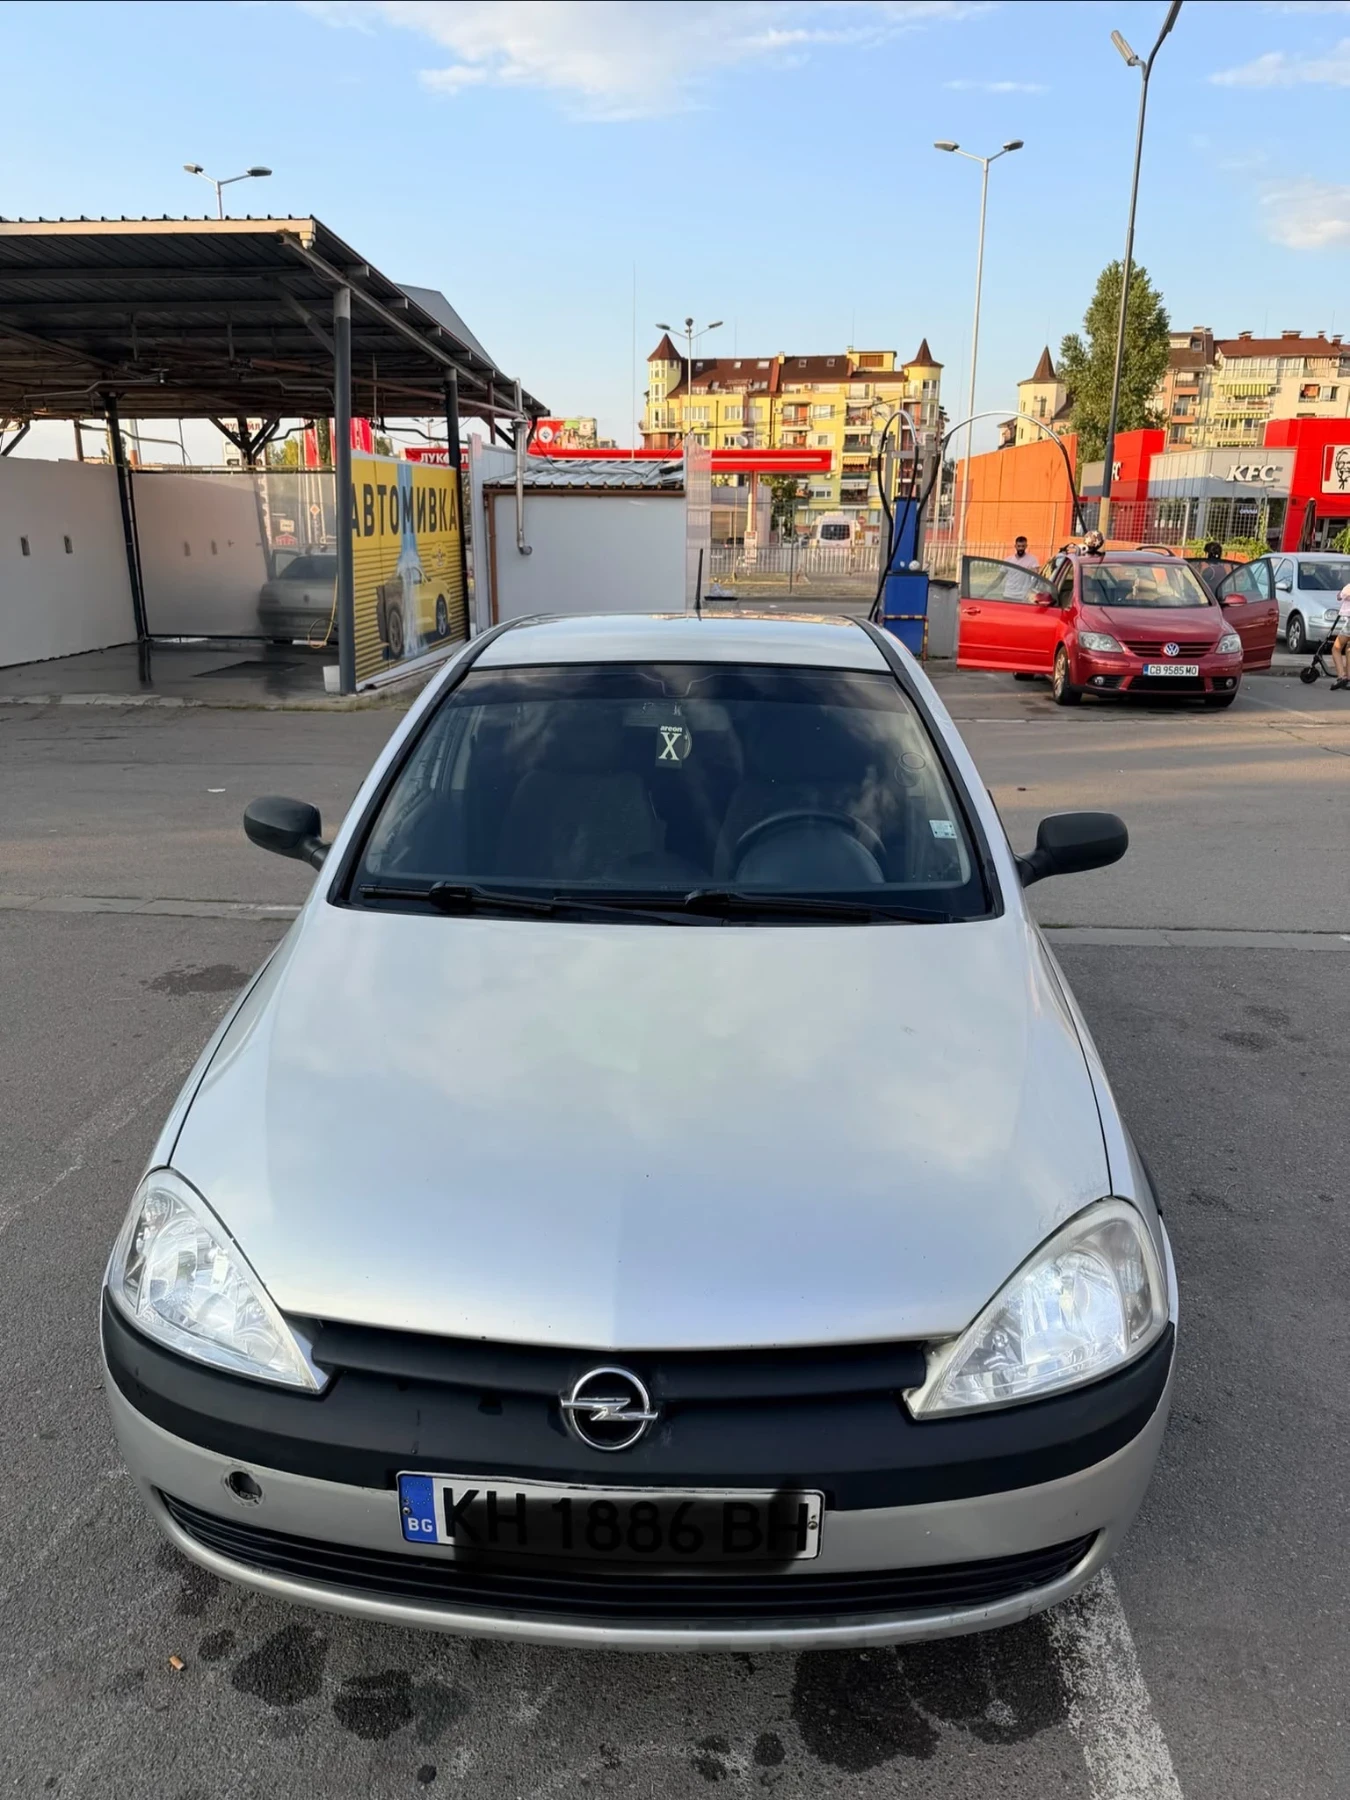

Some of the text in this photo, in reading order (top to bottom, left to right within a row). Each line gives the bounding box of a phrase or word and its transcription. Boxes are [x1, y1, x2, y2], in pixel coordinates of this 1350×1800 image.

[1226, 464, 1277, 482] KFC
[351, 483, 458, 538] АВТОМИВКА
[1150, 665, 1197, 675] CB 9585 MO
[658, 731, 682, 760] X
[407, 1517, 433, 1533] BG
[442, 1487, 809, 1555] KH 1886 BH
